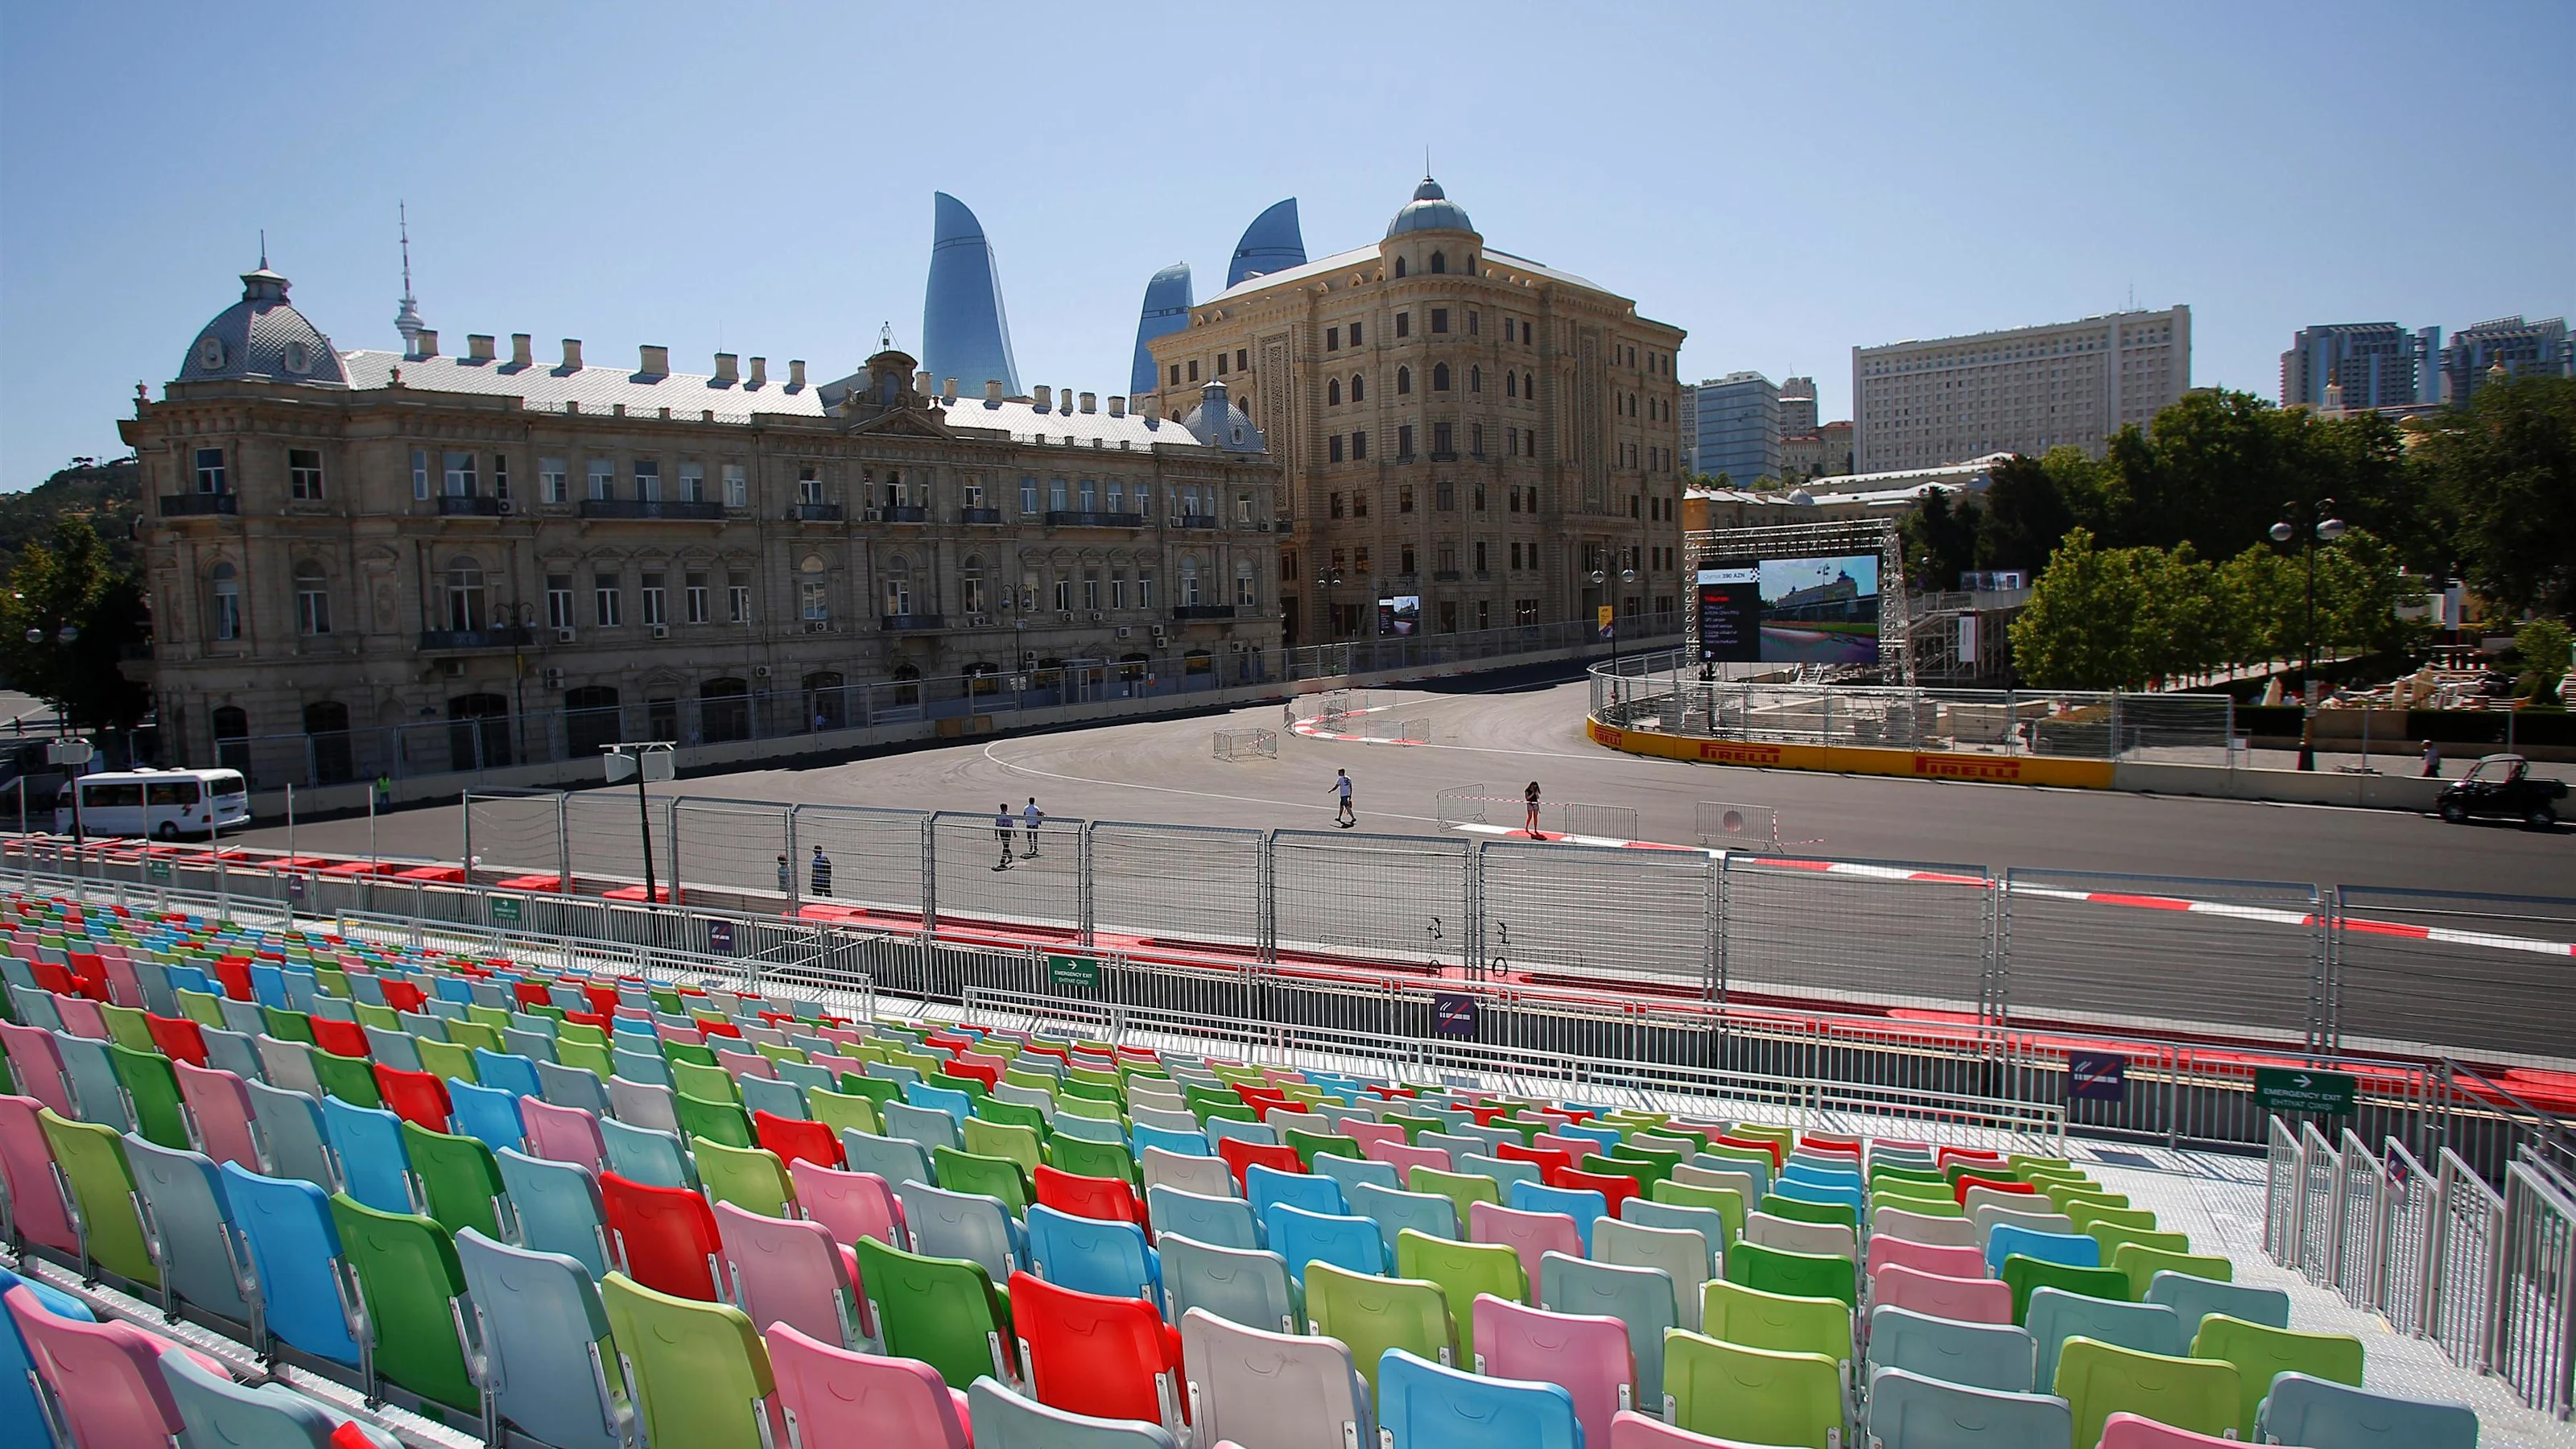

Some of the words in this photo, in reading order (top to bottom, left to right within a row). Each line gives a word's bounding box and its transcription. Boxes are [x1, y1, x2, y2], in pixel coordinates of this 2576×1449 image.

[1595, 726, 1622, 746] PIRELLI
[1700, 742, 1781, 763] PIRELLI
[1915, 756, 2021, 778] PIRELLI
[2263, 1088, 2319, 1100] EMERGENCY
[2322, 1093, 2342, 1101] EXIT
